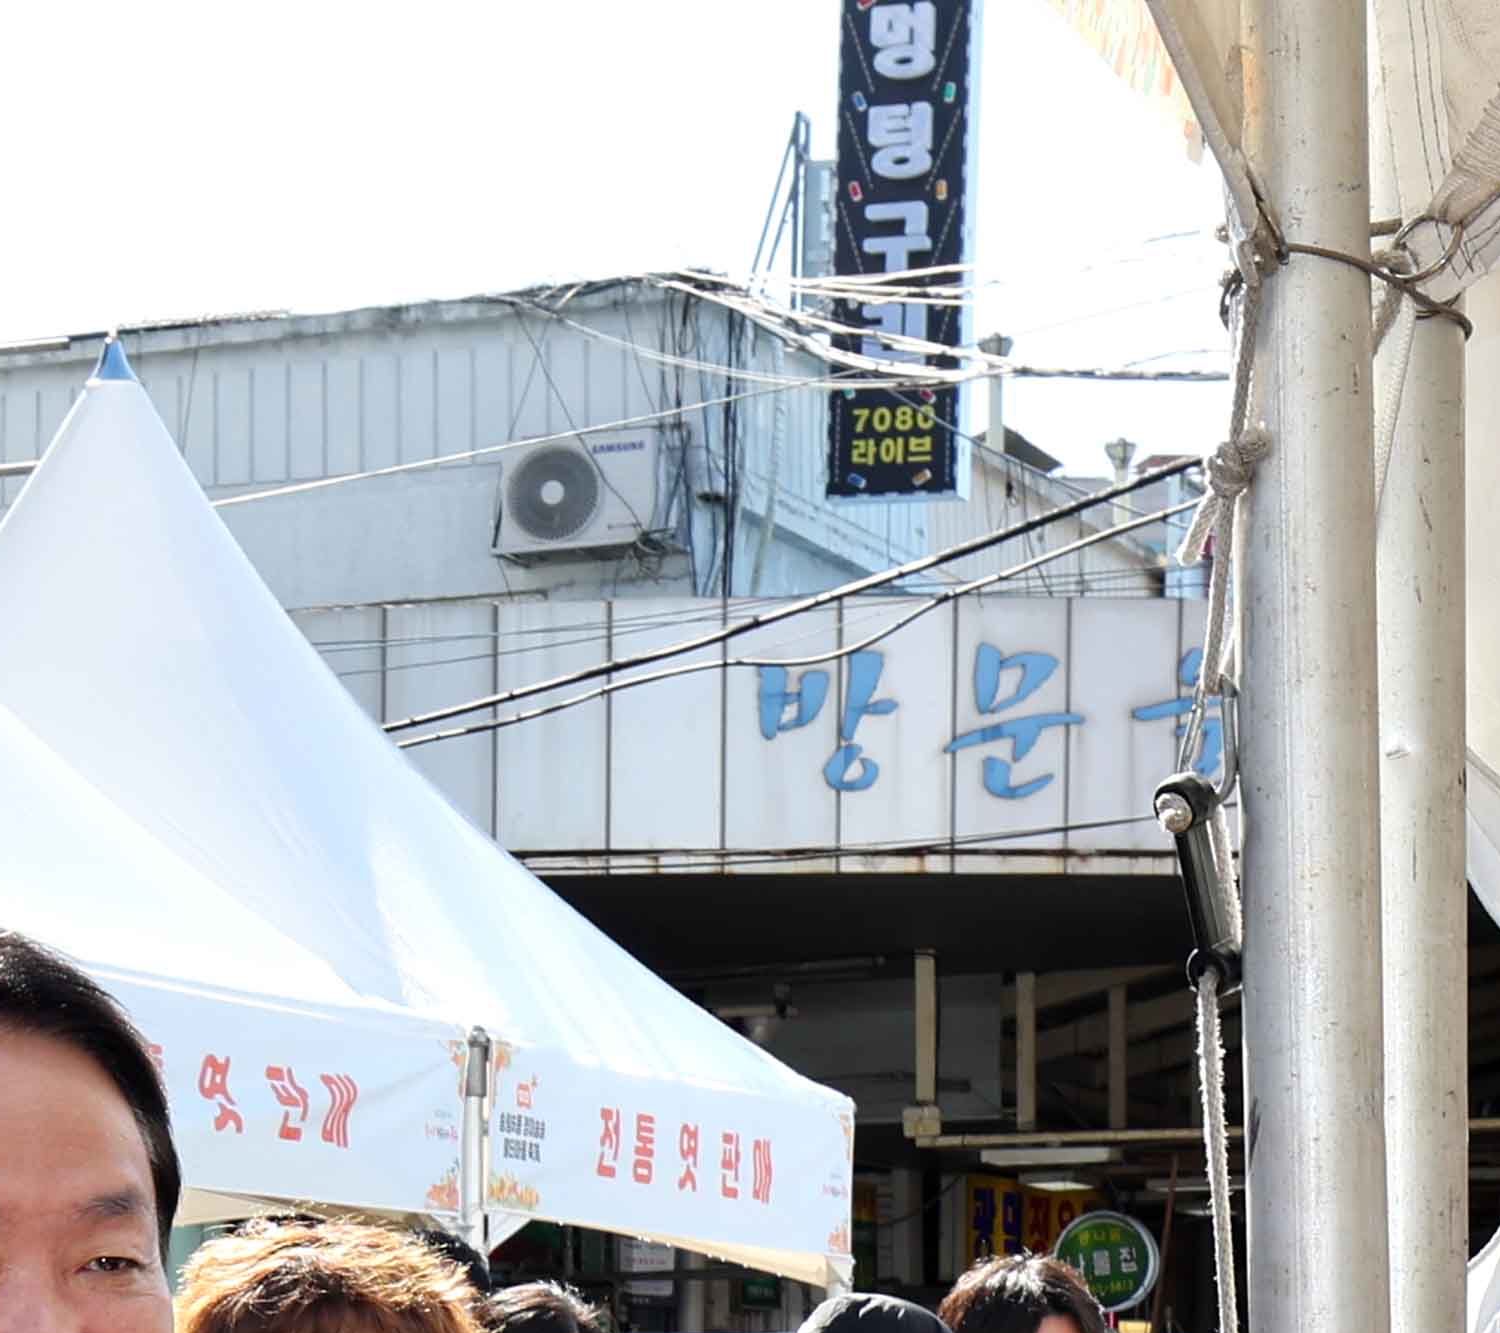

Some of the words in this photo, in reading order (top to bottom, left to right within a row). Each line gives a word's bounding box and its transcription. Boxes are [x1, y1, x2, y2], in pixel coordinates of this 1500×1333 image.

[850, 437, 933, 464] 라이브
[852, 406, 934, 434] 7080
[148, 1043, 358, 1149] 엿판매
[596, 1107, 772, 1204] 전통엿판매
